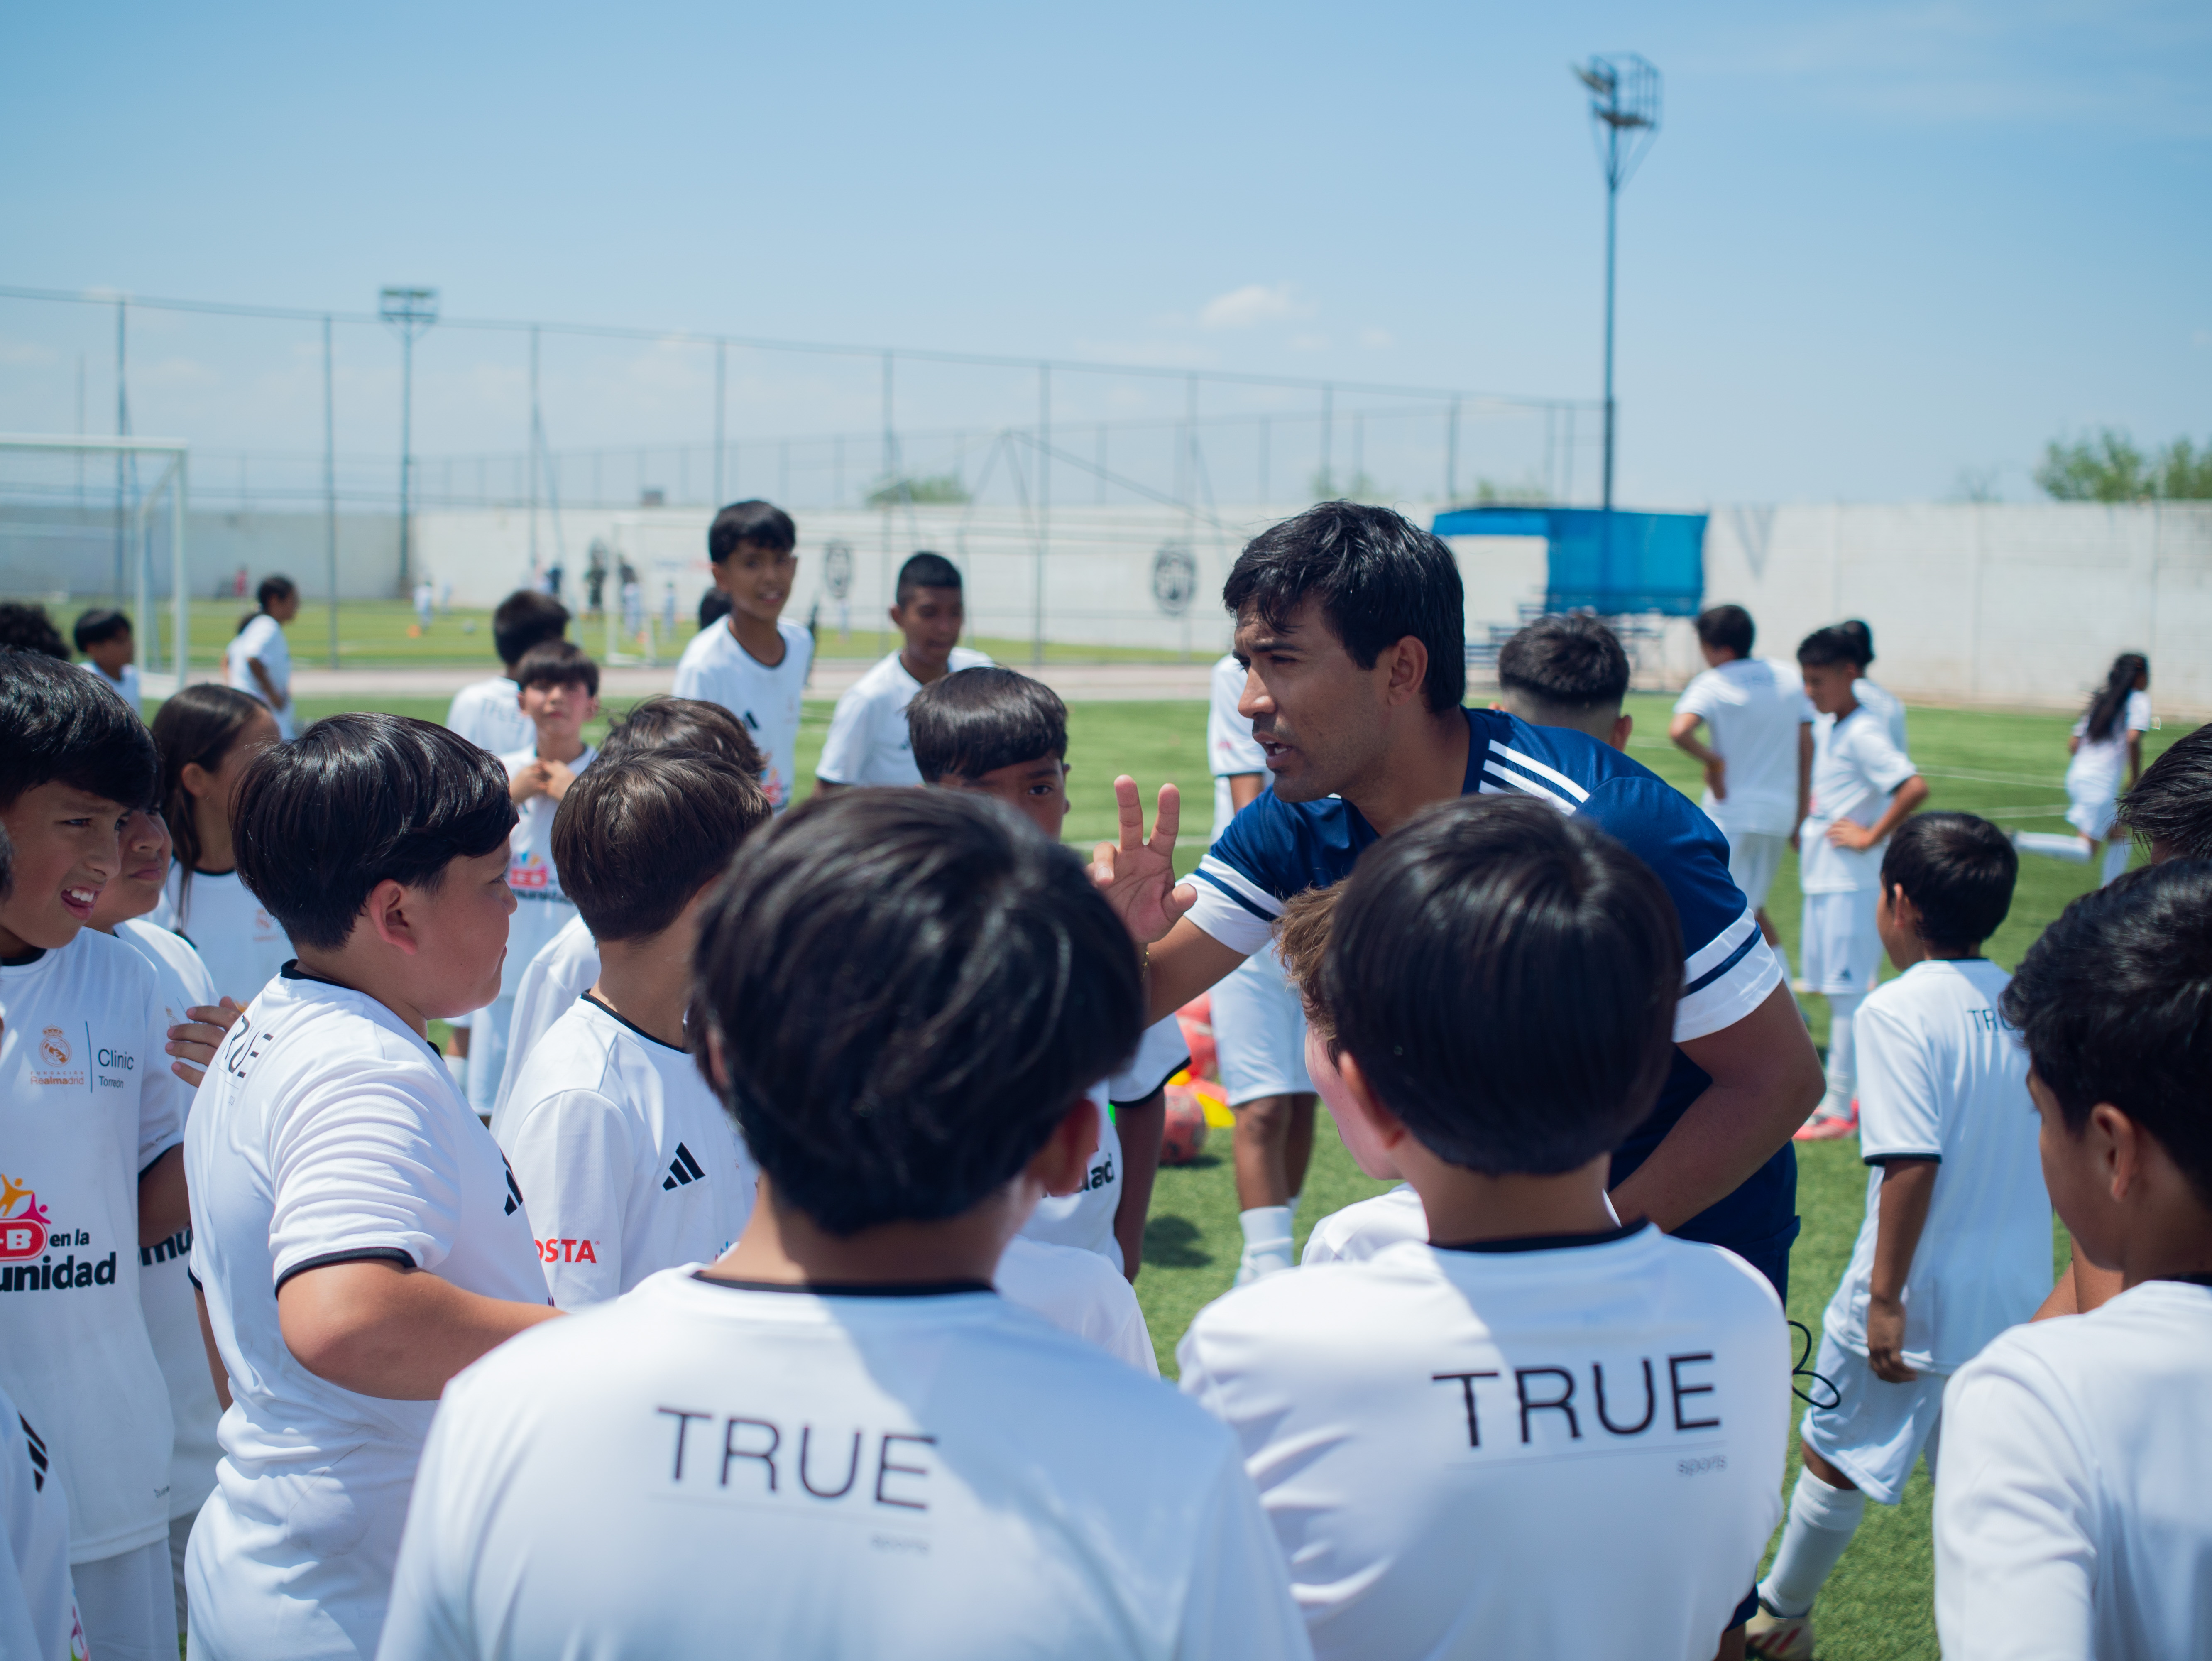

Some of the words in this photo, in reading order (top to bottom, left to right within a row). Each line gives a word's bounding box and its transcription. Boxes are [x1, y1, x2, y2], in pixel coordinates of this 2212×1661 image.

[98, 1049, 134, 1070] Clinic
[98, 1075, 124, 1088] Torreón
[49, 1234, 71, 1247] en
[74, 1229, 90, 1245] la
[1431, 1351, 1720, 1448] TRUE
[658, 1407, 937, 1510] TRUE
